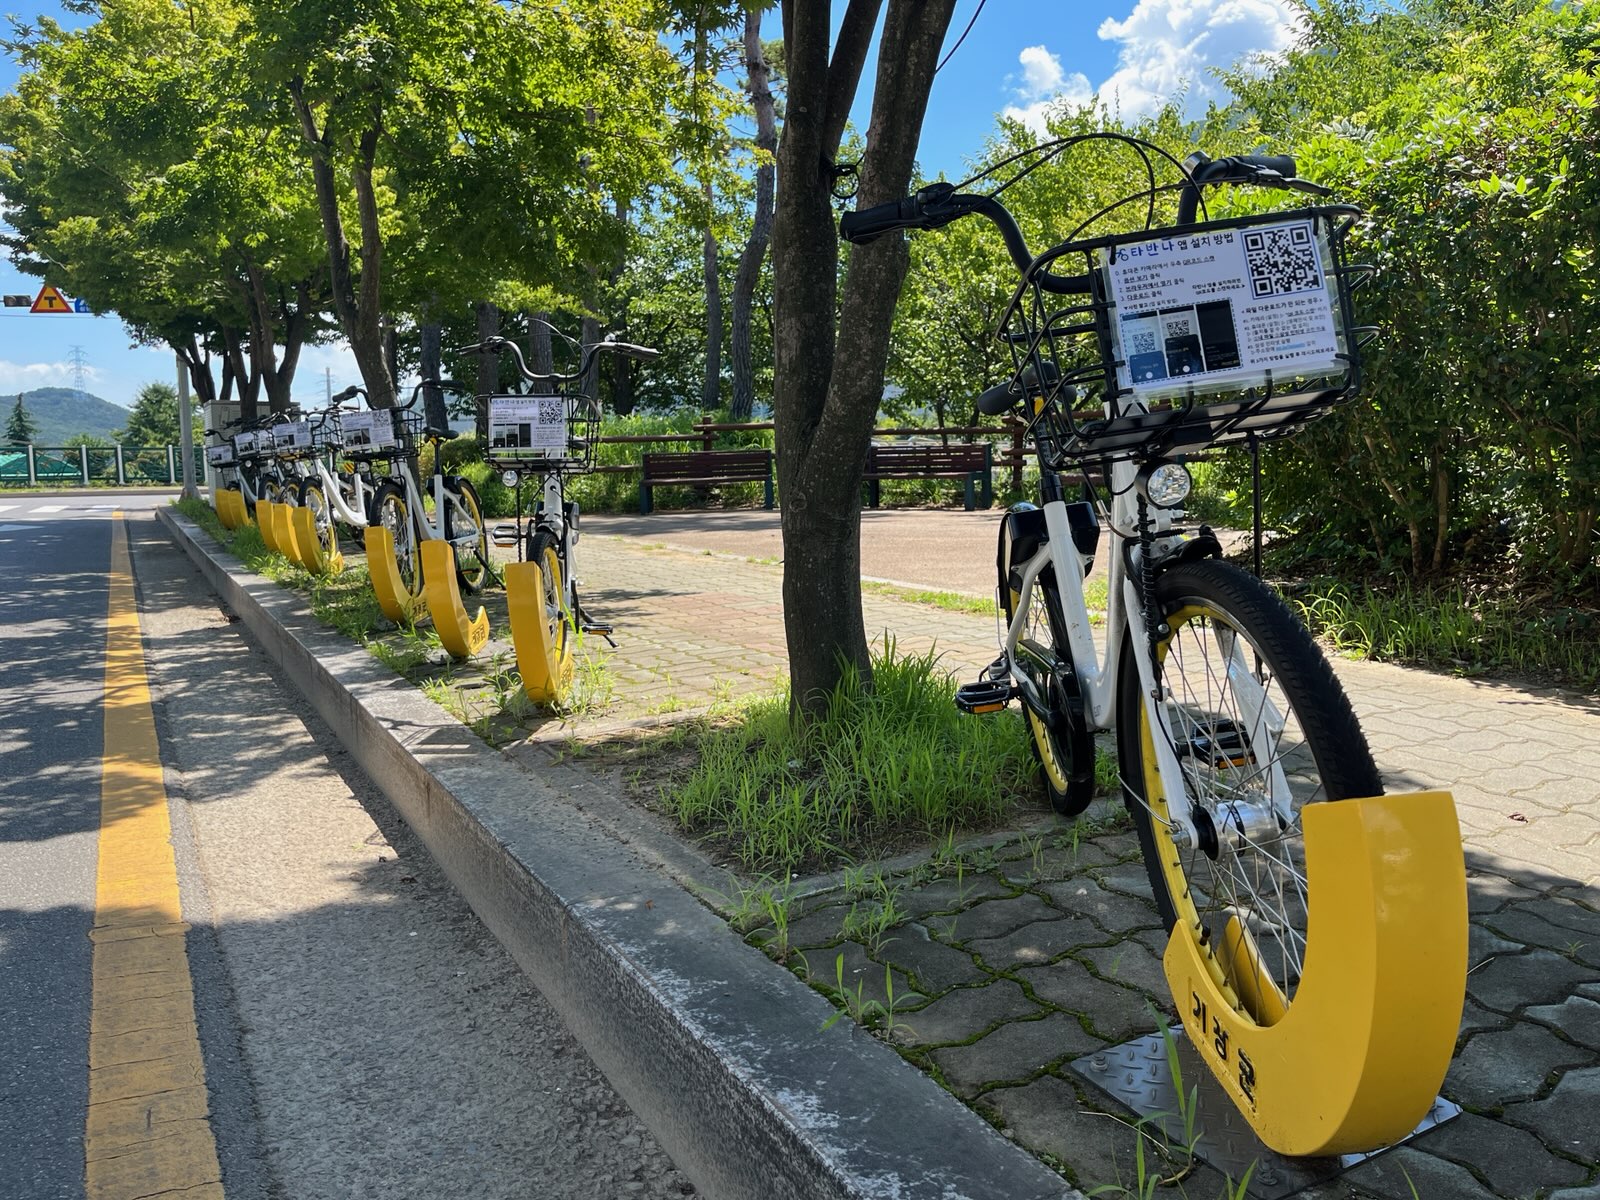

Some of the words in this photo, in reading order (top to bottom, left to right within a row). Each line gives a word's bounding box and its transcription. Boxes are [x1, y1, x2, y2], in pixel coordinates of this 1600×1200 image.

[1131, 241, 1175, 257] 타반나
[1177, 240, 1188, 250] 앱
[1190, 236, 1211, 248] 설치
[1213, 232, 1234, 245] 방법
[1192, 991, 1256, 1113] 기장군
